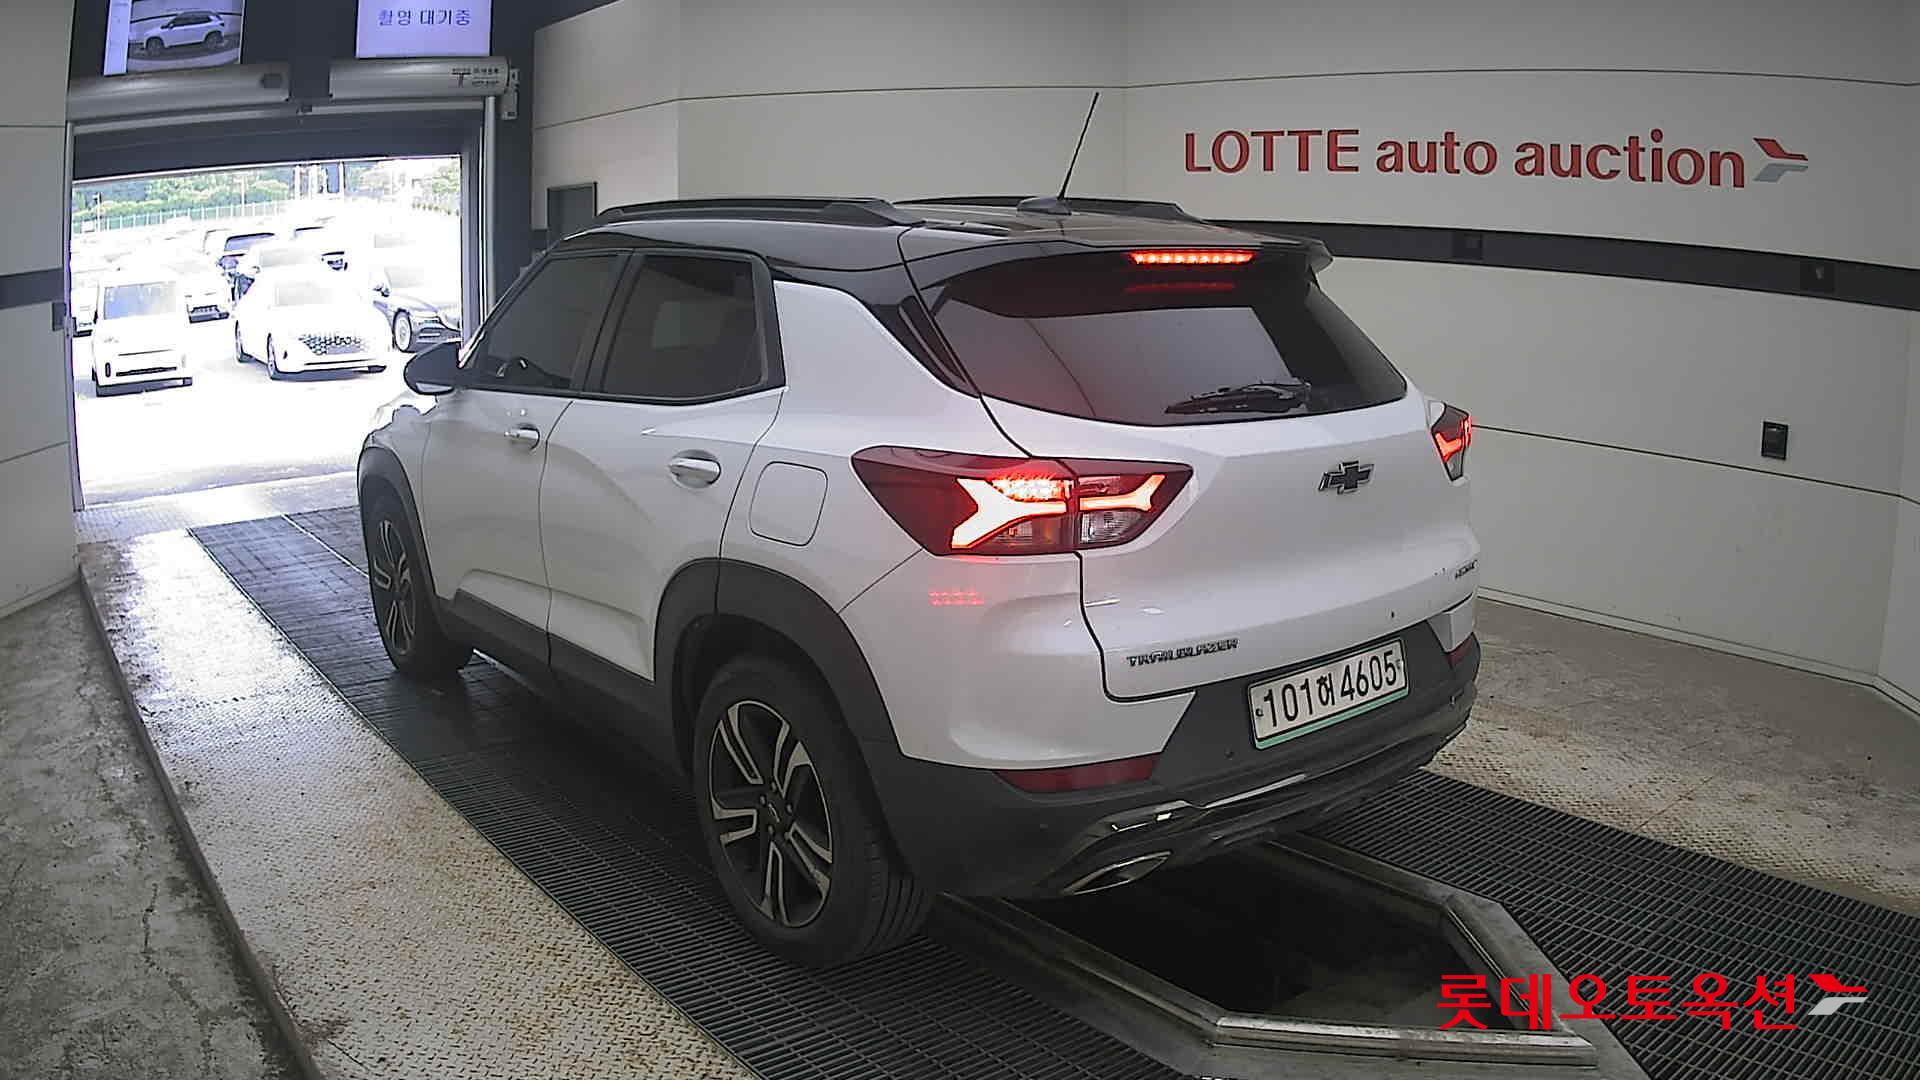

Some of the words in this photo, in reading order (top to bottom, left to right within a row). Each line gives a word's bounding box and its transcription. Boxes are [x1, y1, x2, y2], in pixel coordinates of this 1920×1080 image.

[420, 9, 470, 26] 대기중
[1185, 129, 1359, 173] LOTTE
[1376, 131, 1498, 176] auto
[1514, 128, 1745, 188] auction
